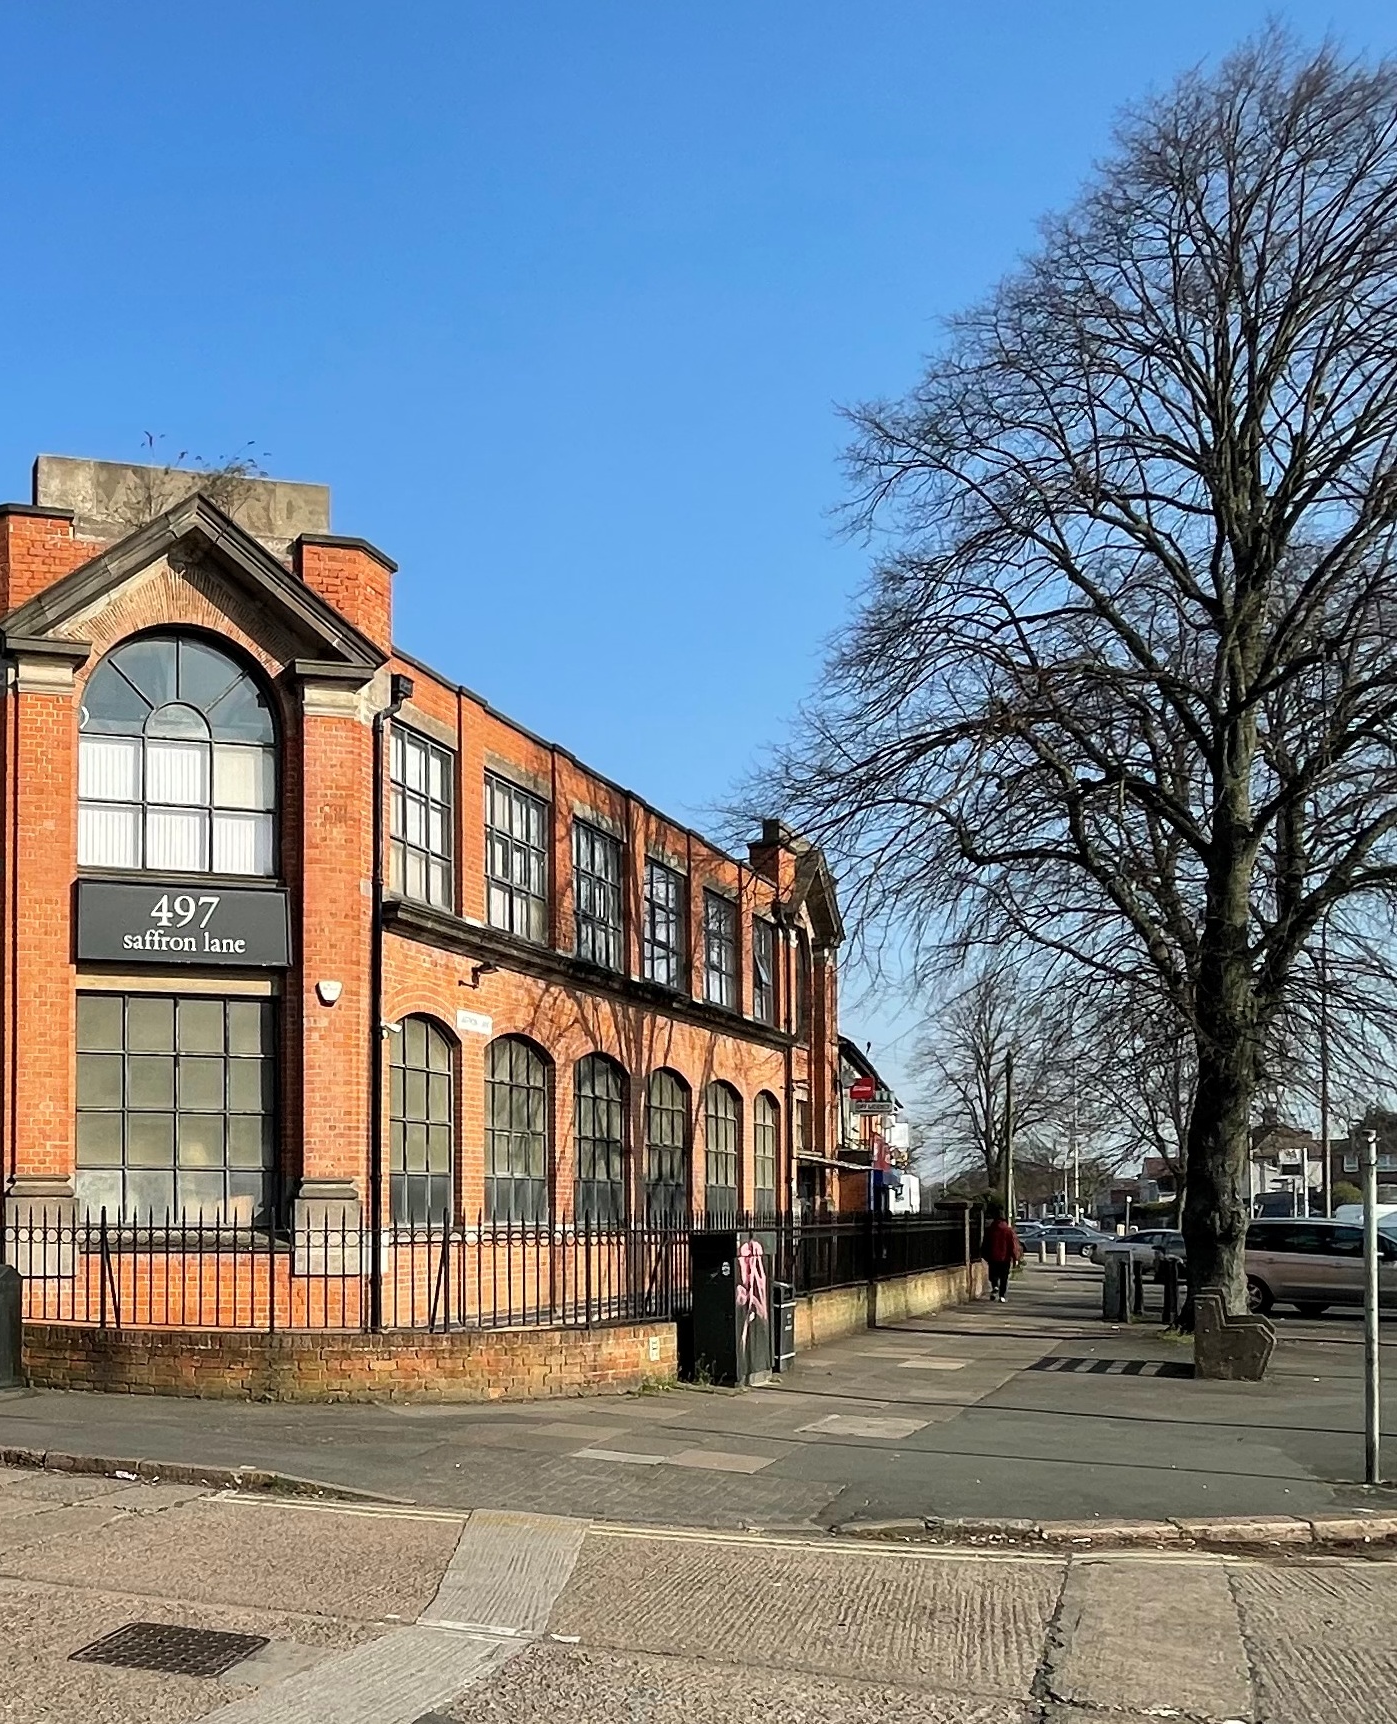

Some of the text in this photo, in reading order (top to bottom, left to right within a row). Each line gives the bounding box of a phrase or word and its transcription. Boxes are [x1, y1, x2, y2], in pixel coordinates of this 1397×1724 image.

[150, 894, 221, 929] 497
[123, 929, 246, 954] saffron lane
